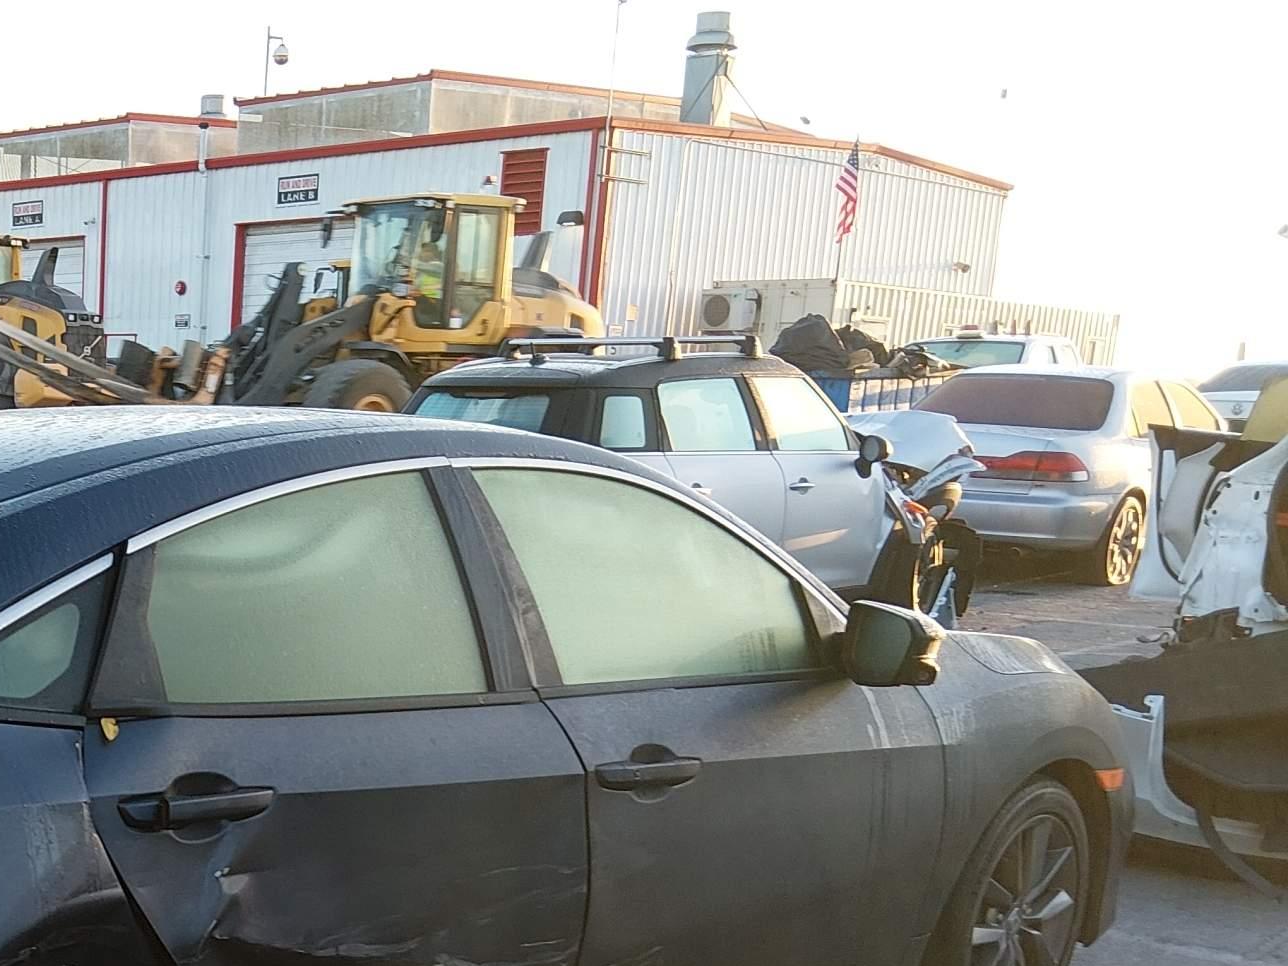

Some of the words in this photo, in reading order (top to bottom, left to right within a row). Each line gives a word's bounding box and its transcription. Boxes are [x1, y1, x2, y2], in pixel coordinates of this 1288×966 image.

[281, 191, 305, 202] LANE
[308, 191, 315, 200] B
[15, 216, 33, 224] LANE
